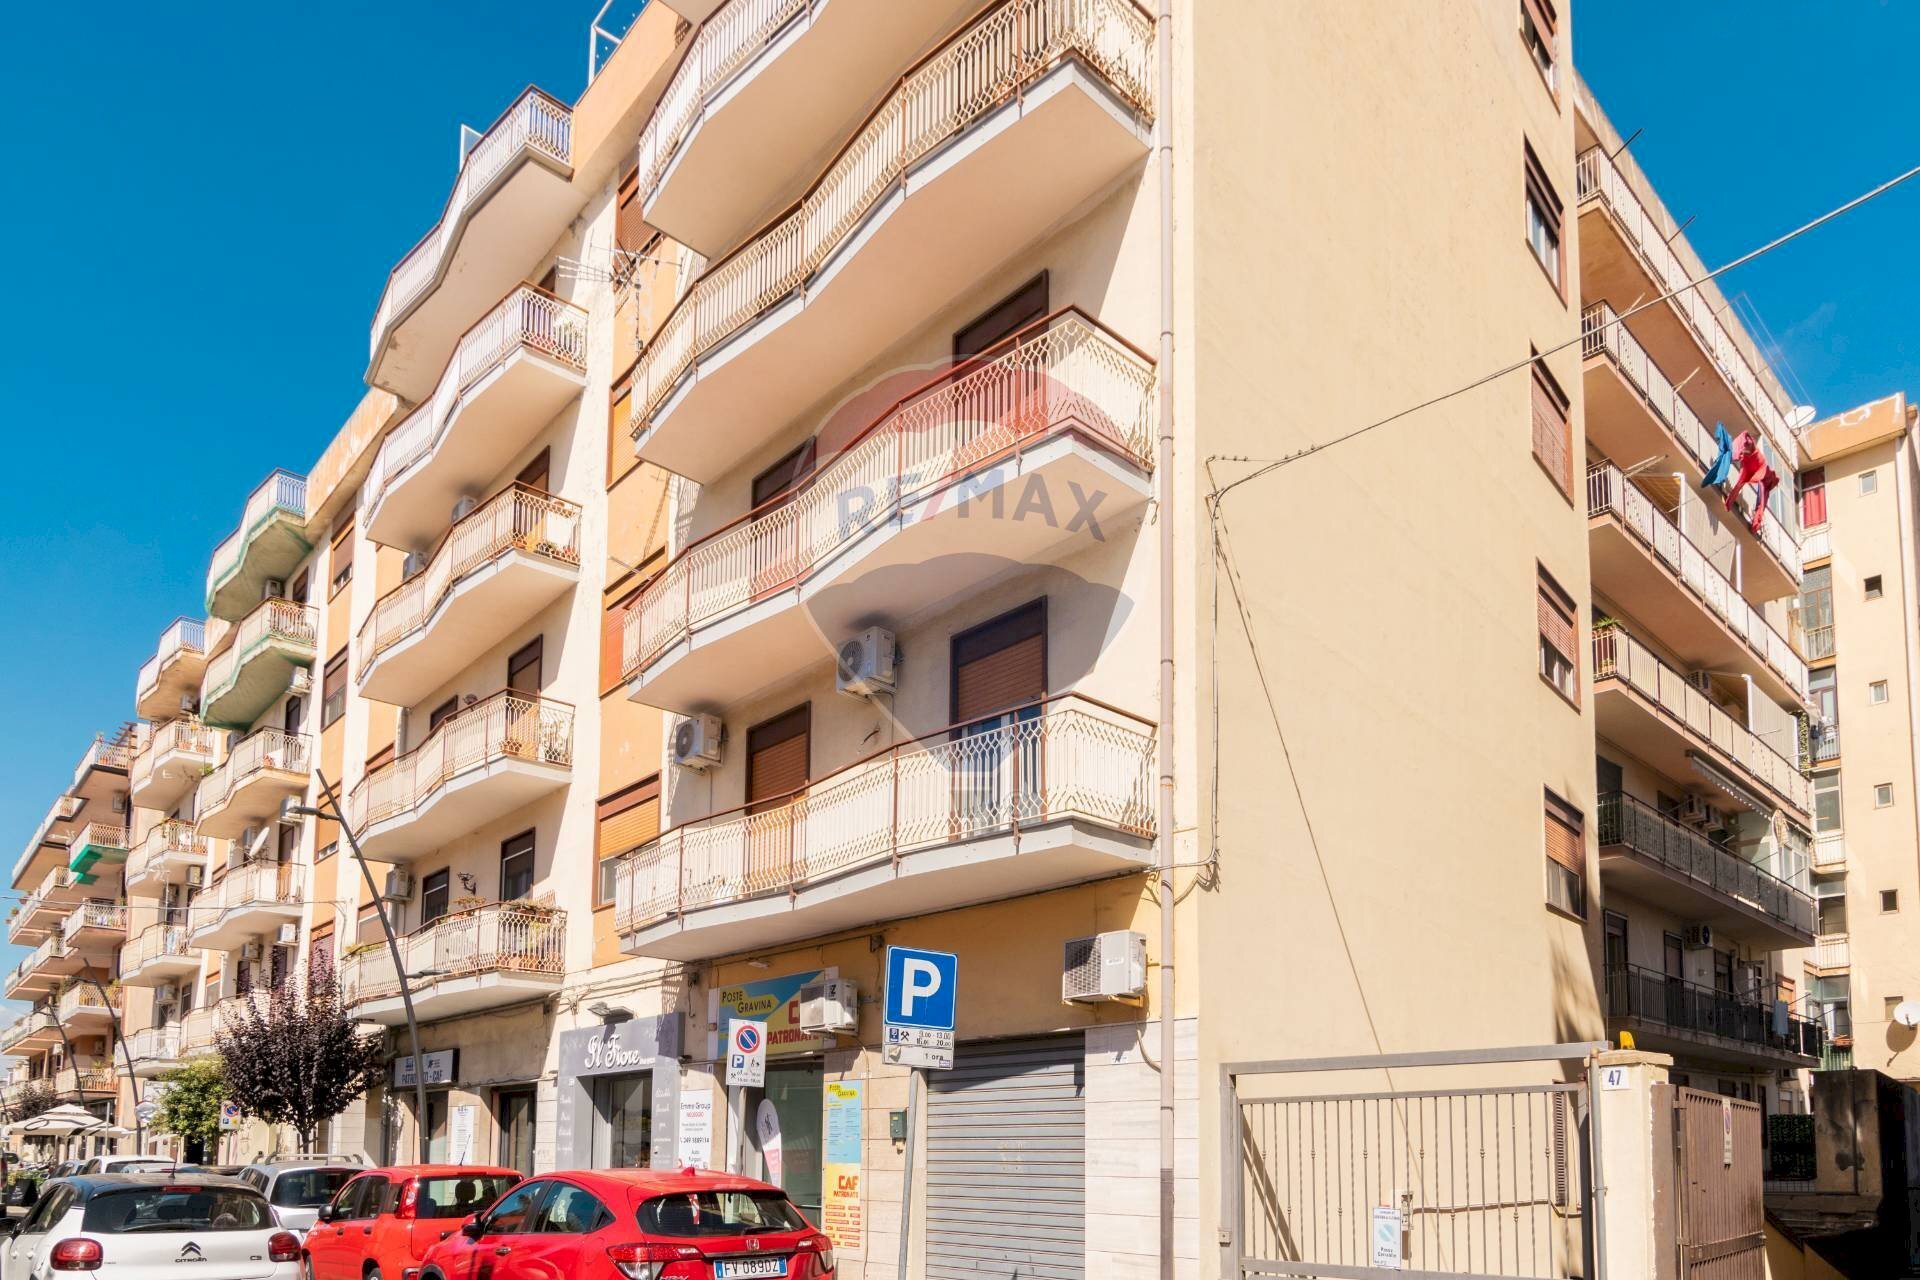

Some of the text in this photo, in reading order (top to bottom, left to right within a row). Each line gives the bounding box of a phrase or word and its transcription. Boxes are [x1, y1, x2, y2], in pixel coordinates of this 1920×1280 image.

[901, 957, 941, 1016] P
[722, 991, 743, 1003] POSTE
[737, 999, 772, 1013] GRAVINA
[605, 1034, 640, 1069] Fiore
[402, 1072, 429, 1085] PATROTO
[1608, 1070, 1621, 1086] 47
[838, 1175, 859, 1190] CAF
[724, 1261, 738, 1277] FV
